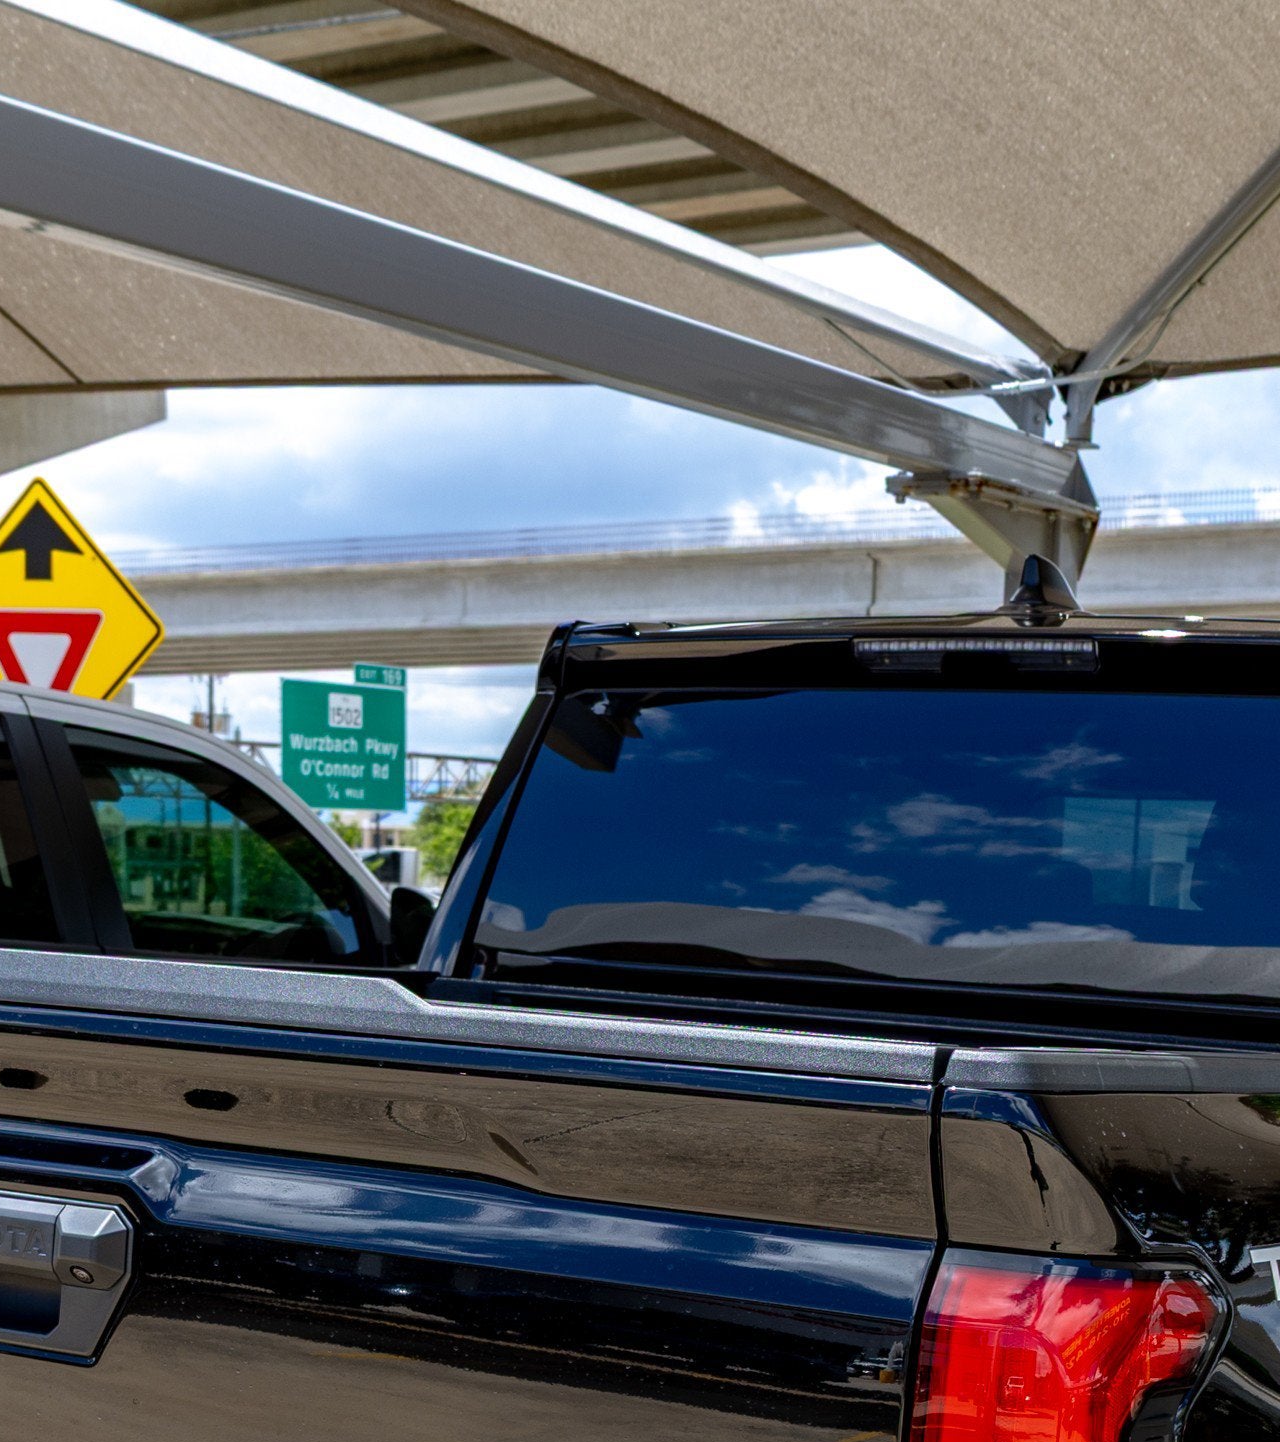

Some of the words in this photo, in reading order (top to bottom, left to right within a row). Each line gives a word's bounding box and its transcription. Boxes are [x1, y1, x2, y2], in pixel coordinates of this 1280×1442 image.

[382, 669, 402, 685] 169
[331, 707, 362, 726] 1502
[289, 733, 358, 753] Wurzbach
[365, 738, 399, 760] Pkwy
[301, 759, 364, 778] O'Connor
[372, 763, 389, 779] Rd
